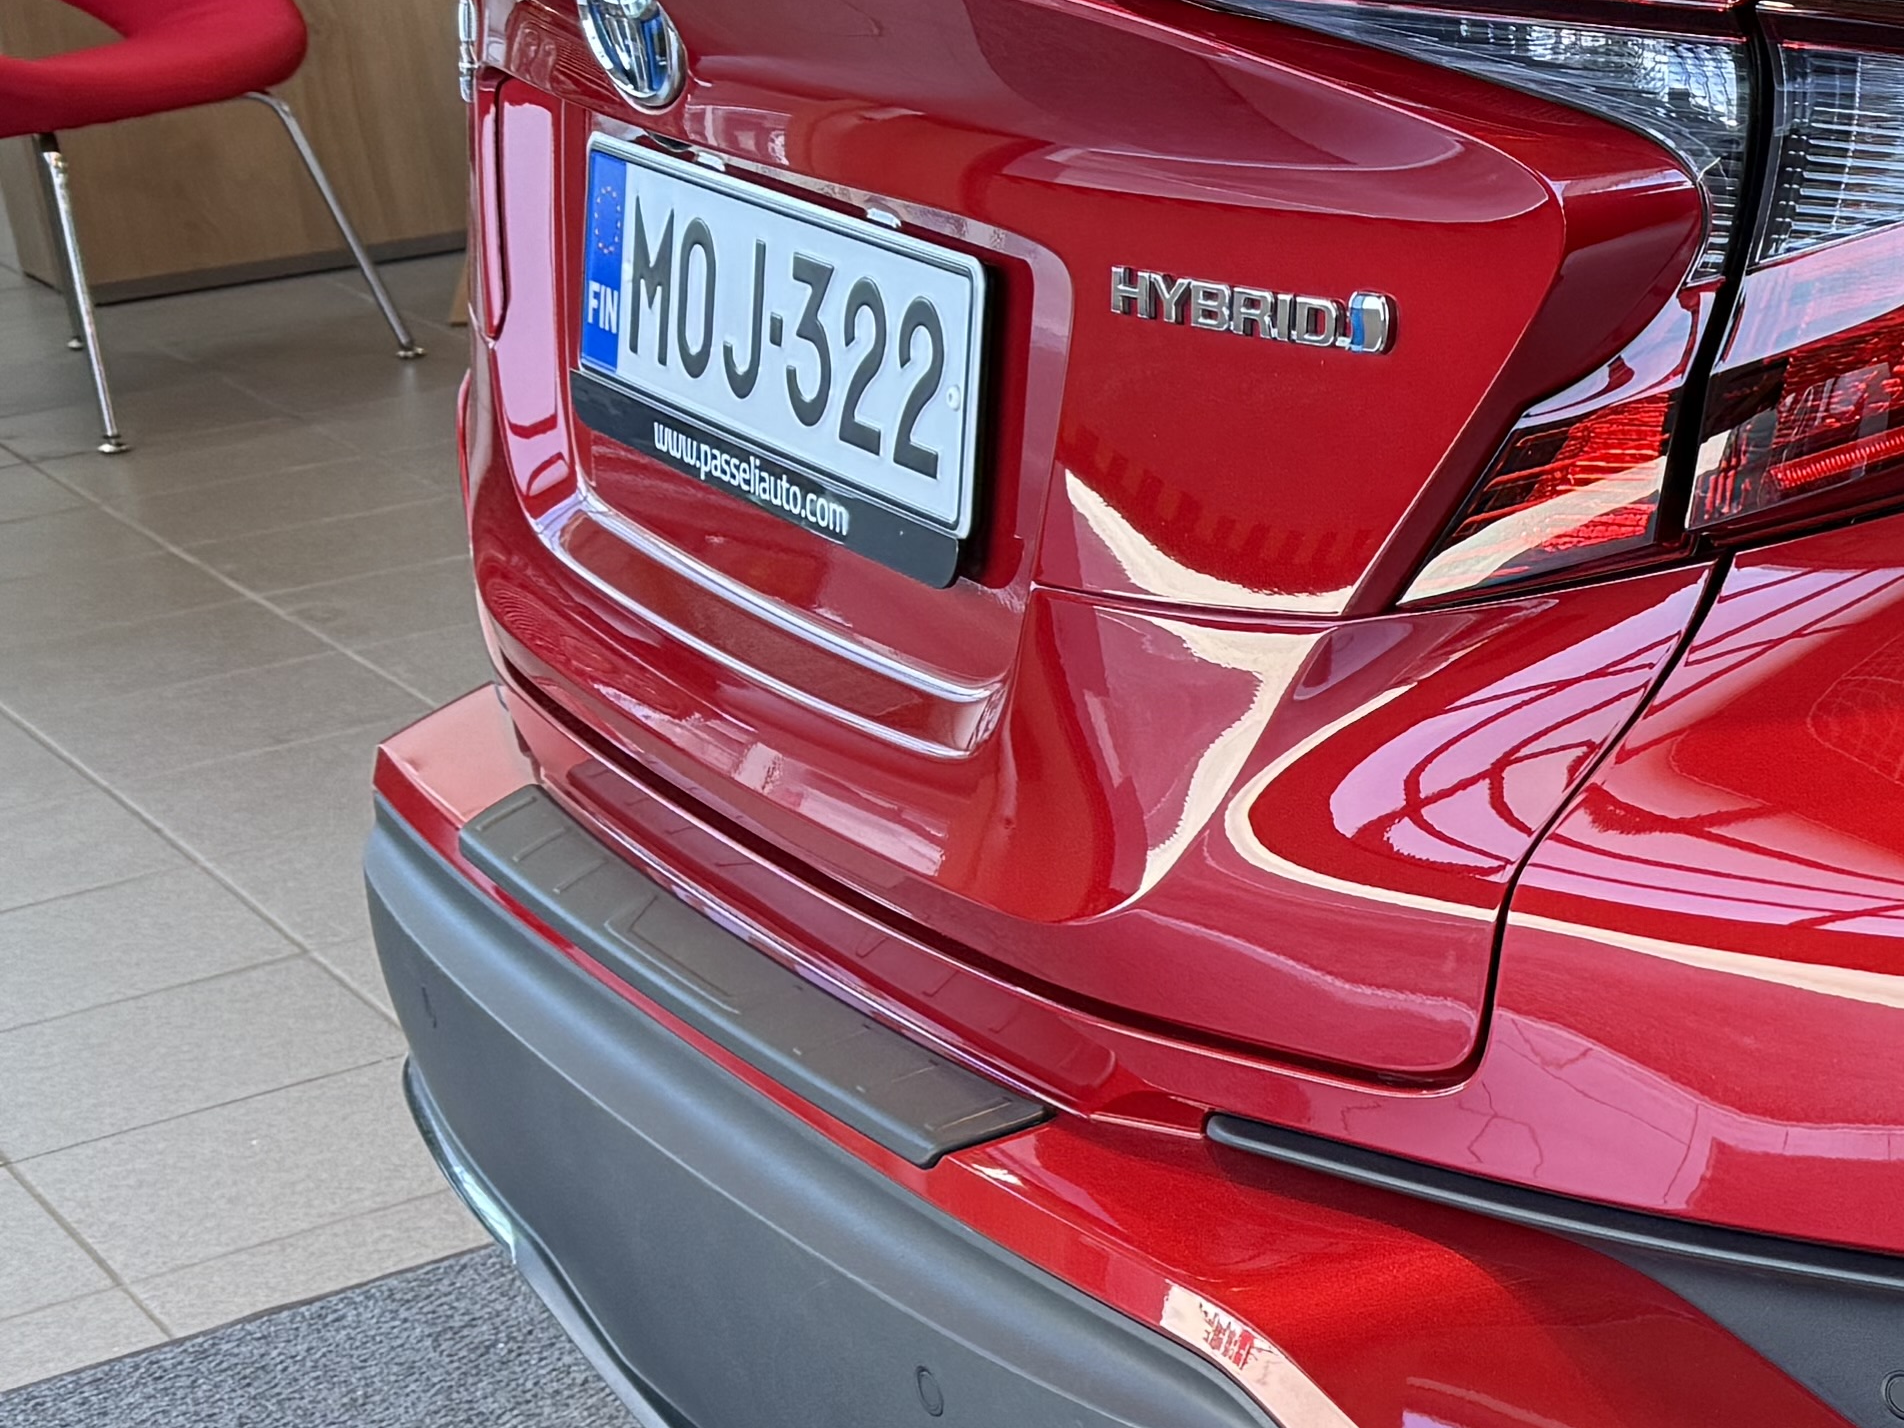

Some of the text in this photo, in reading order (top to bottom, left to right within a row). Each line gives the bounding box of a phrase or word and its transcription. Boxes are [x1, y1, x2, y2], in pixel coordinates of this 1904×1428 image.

[586, 280, 619, 335] FIN
[629, 193, 945, 480] MOJ-322
[1110, 264, 1343, 348] HYBRID
[653, 422, 849, 536] www.passeliauto.com
